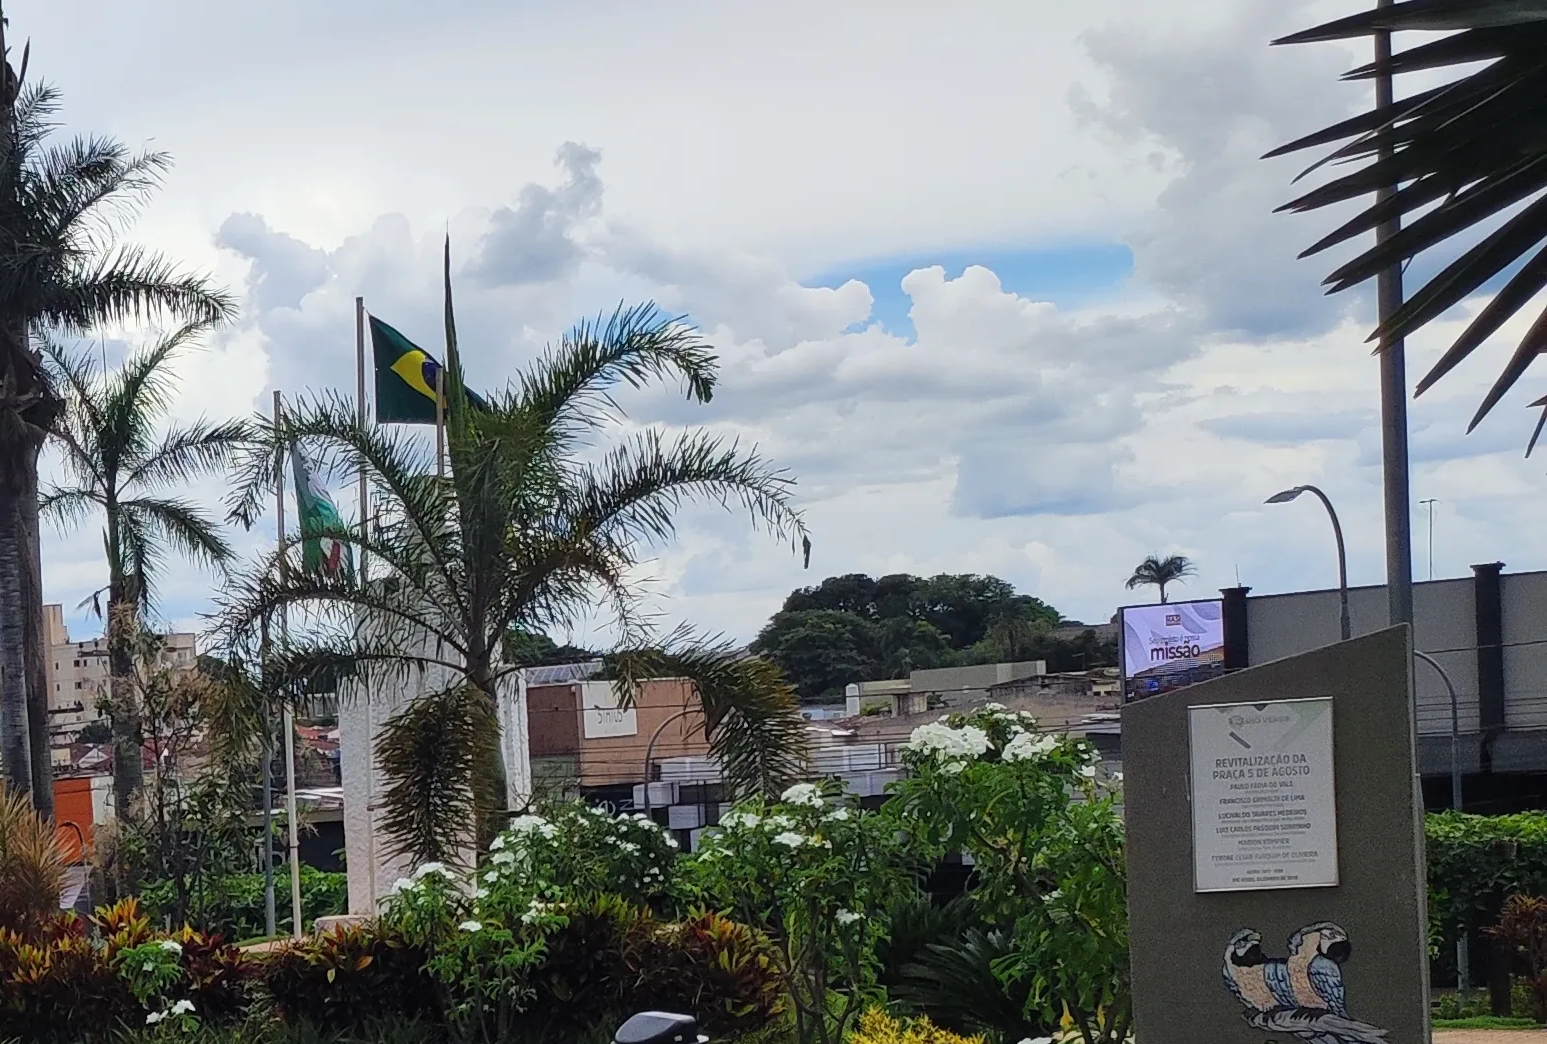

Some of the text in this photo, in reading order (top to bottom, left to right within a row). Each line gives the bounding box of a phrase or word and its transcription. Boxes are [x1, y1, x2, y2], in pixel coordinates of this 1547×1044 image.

[1150, 640, 1201, 661] missão
[1215, 753, 1307, 769] REVITALIZAÇÃO DA
[1213, 765, 1310, 781] PRAÇA 5 DE AGOSTO
